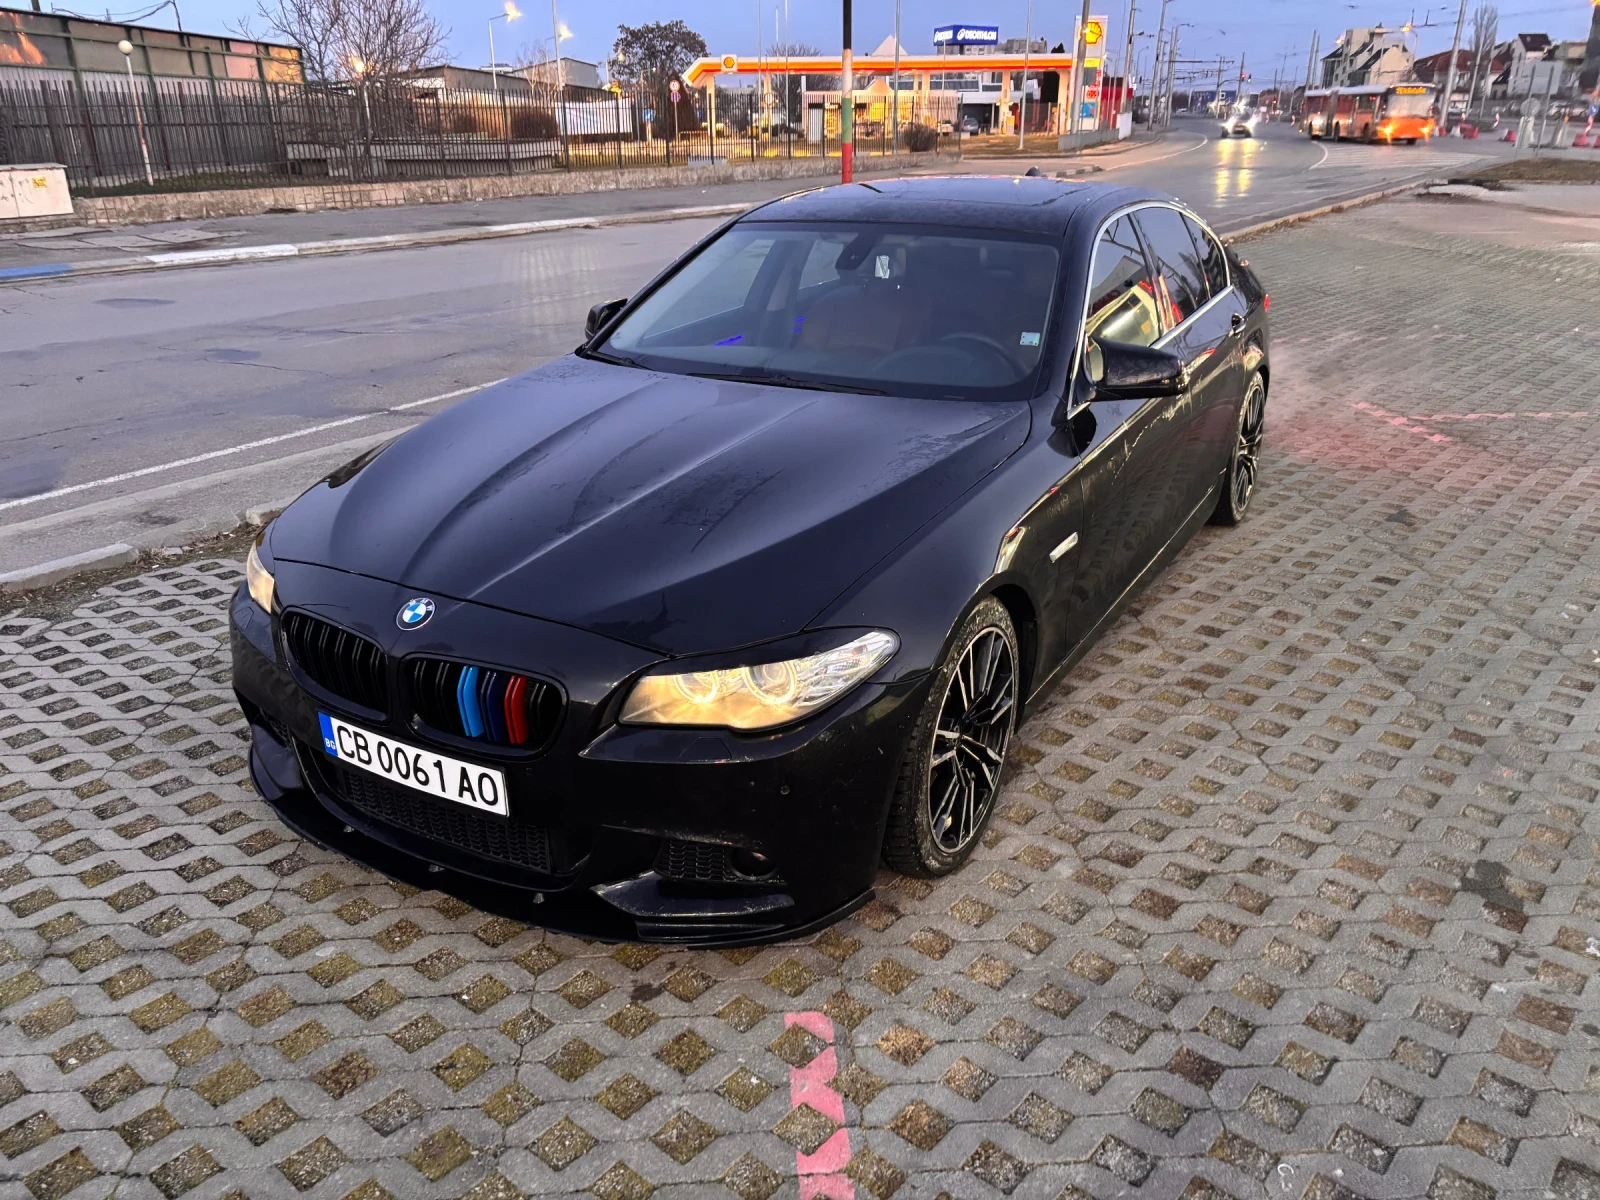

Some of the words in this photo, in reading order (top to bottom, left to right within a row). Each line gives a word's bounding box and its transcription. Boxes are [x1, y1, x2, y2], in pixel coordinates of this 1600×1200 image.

[964, 29, 997, 41] DECATHLON
[324, 737, 337, 750] BG
[336, 725, 372, 766] CB
[377, 741, 447, 793] 0061
[458, 766, 498, 806] AO
